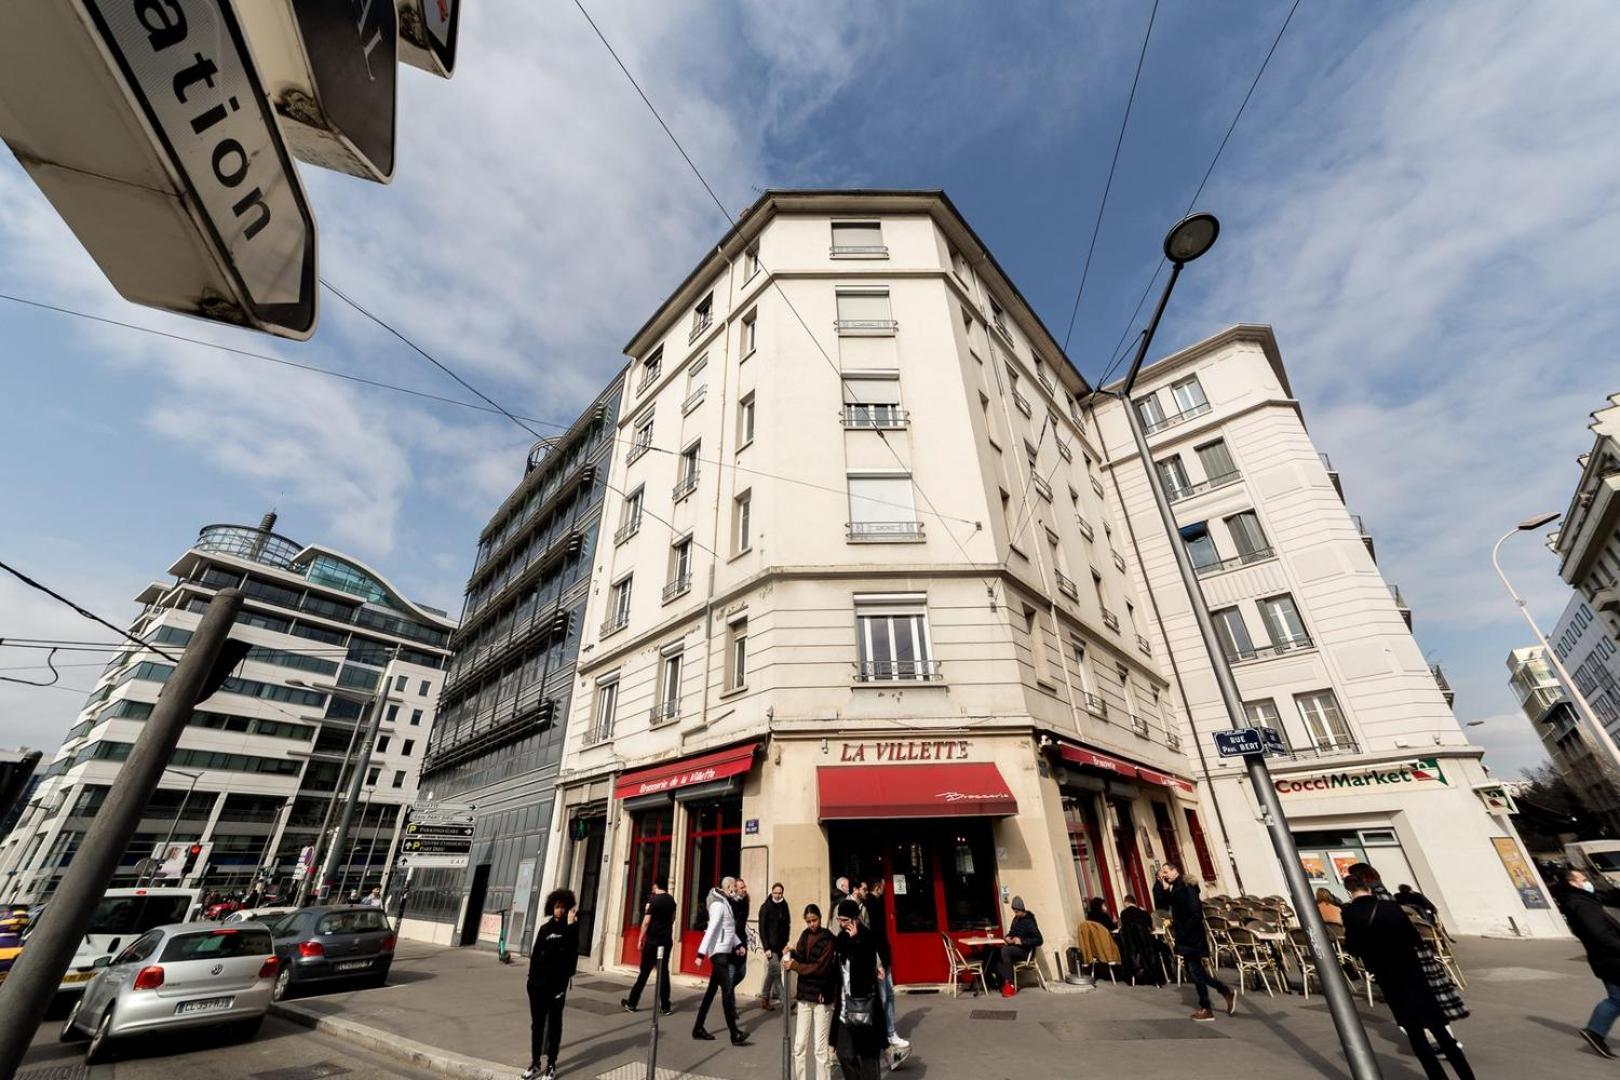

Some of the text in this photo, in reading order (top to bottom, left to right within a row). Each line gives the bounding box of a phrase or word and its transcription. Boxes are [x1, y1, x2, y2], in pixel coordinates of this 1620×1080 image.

[1229, 735, 1246, 744] RUE
[840, 740, 969, 762] LA VILLETTE
[1239, 742, 1259, 752] BERT
[1275, 769, 1412, 794] CocciMarket
[935, 791, 1009, 802] Brasserie
